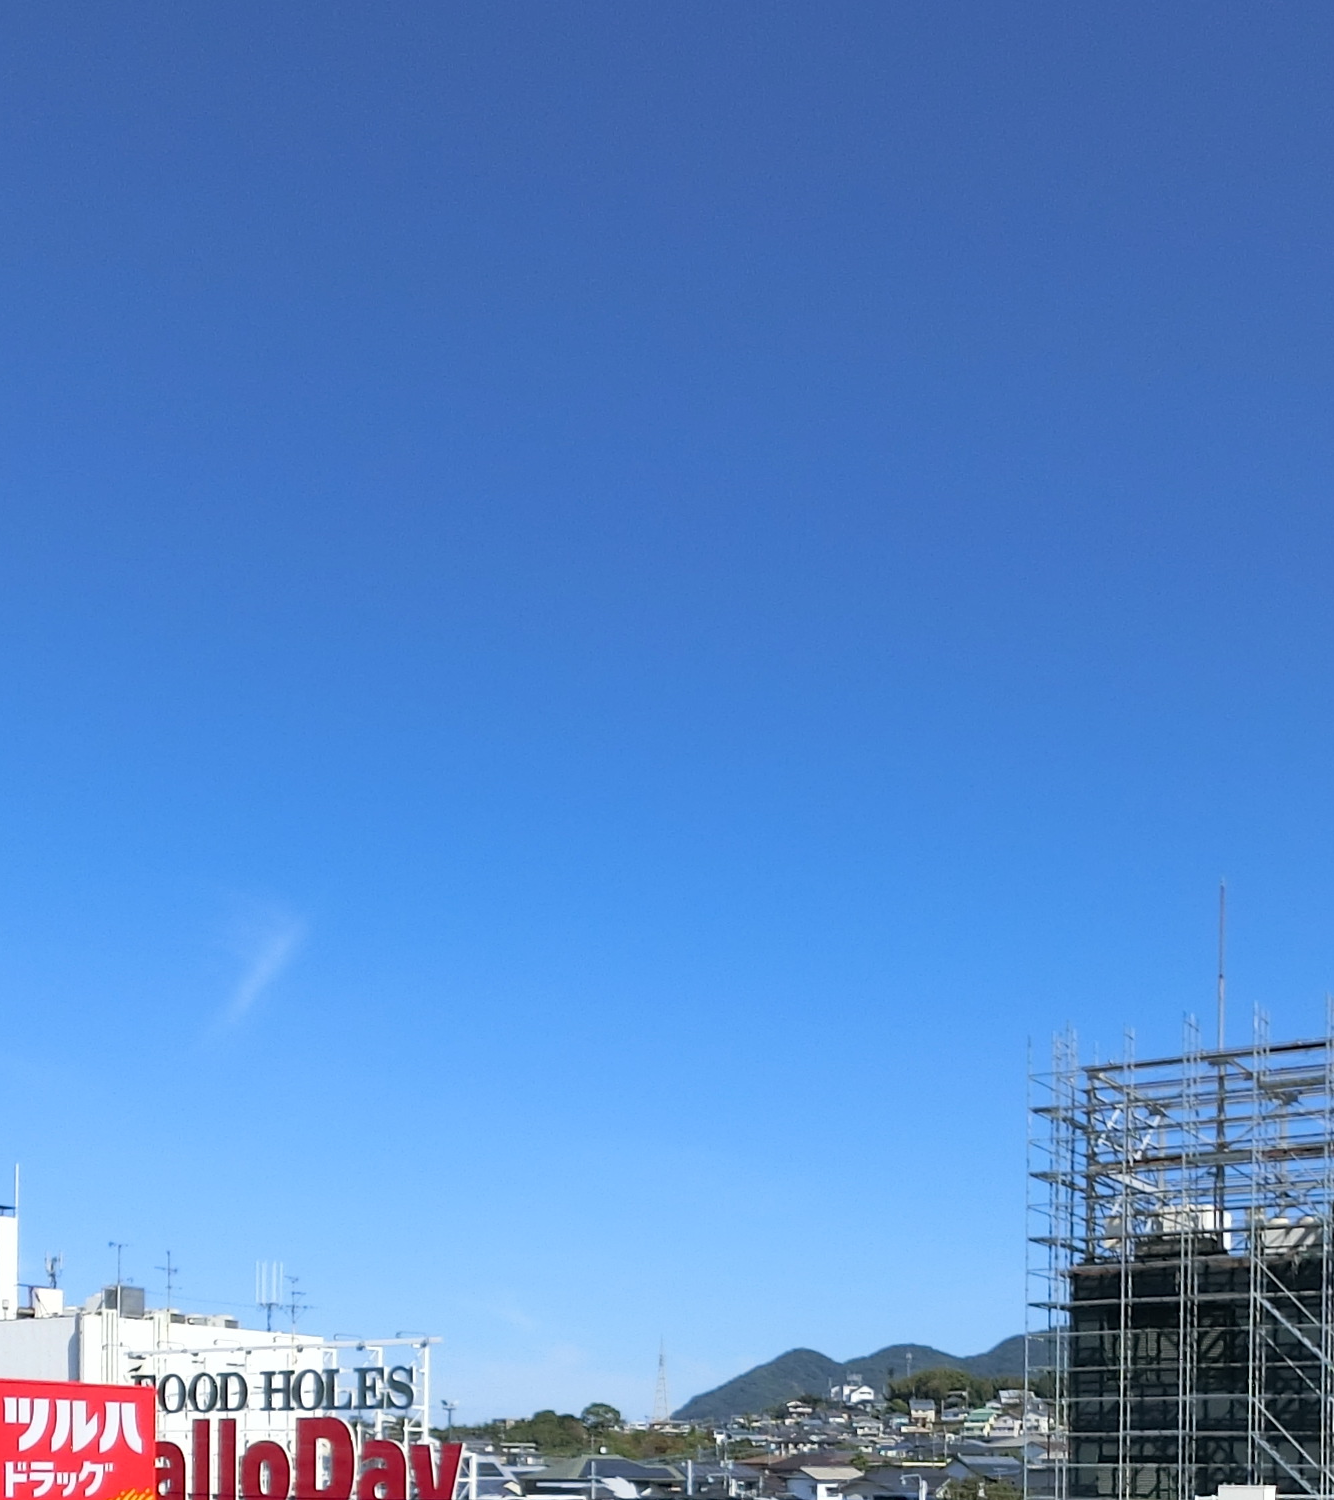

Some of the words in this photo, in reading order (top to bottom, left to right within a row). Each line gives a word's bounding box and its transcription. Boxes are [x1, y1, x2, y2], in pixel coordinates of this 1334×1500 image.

[131, 1372, 248, 1413] OOD
[260, 1366, 415, 1412] HOLES
[3, 1397, 143, 1455] ツルハ
[4, 1459, 114, 1499] ドラッグ
